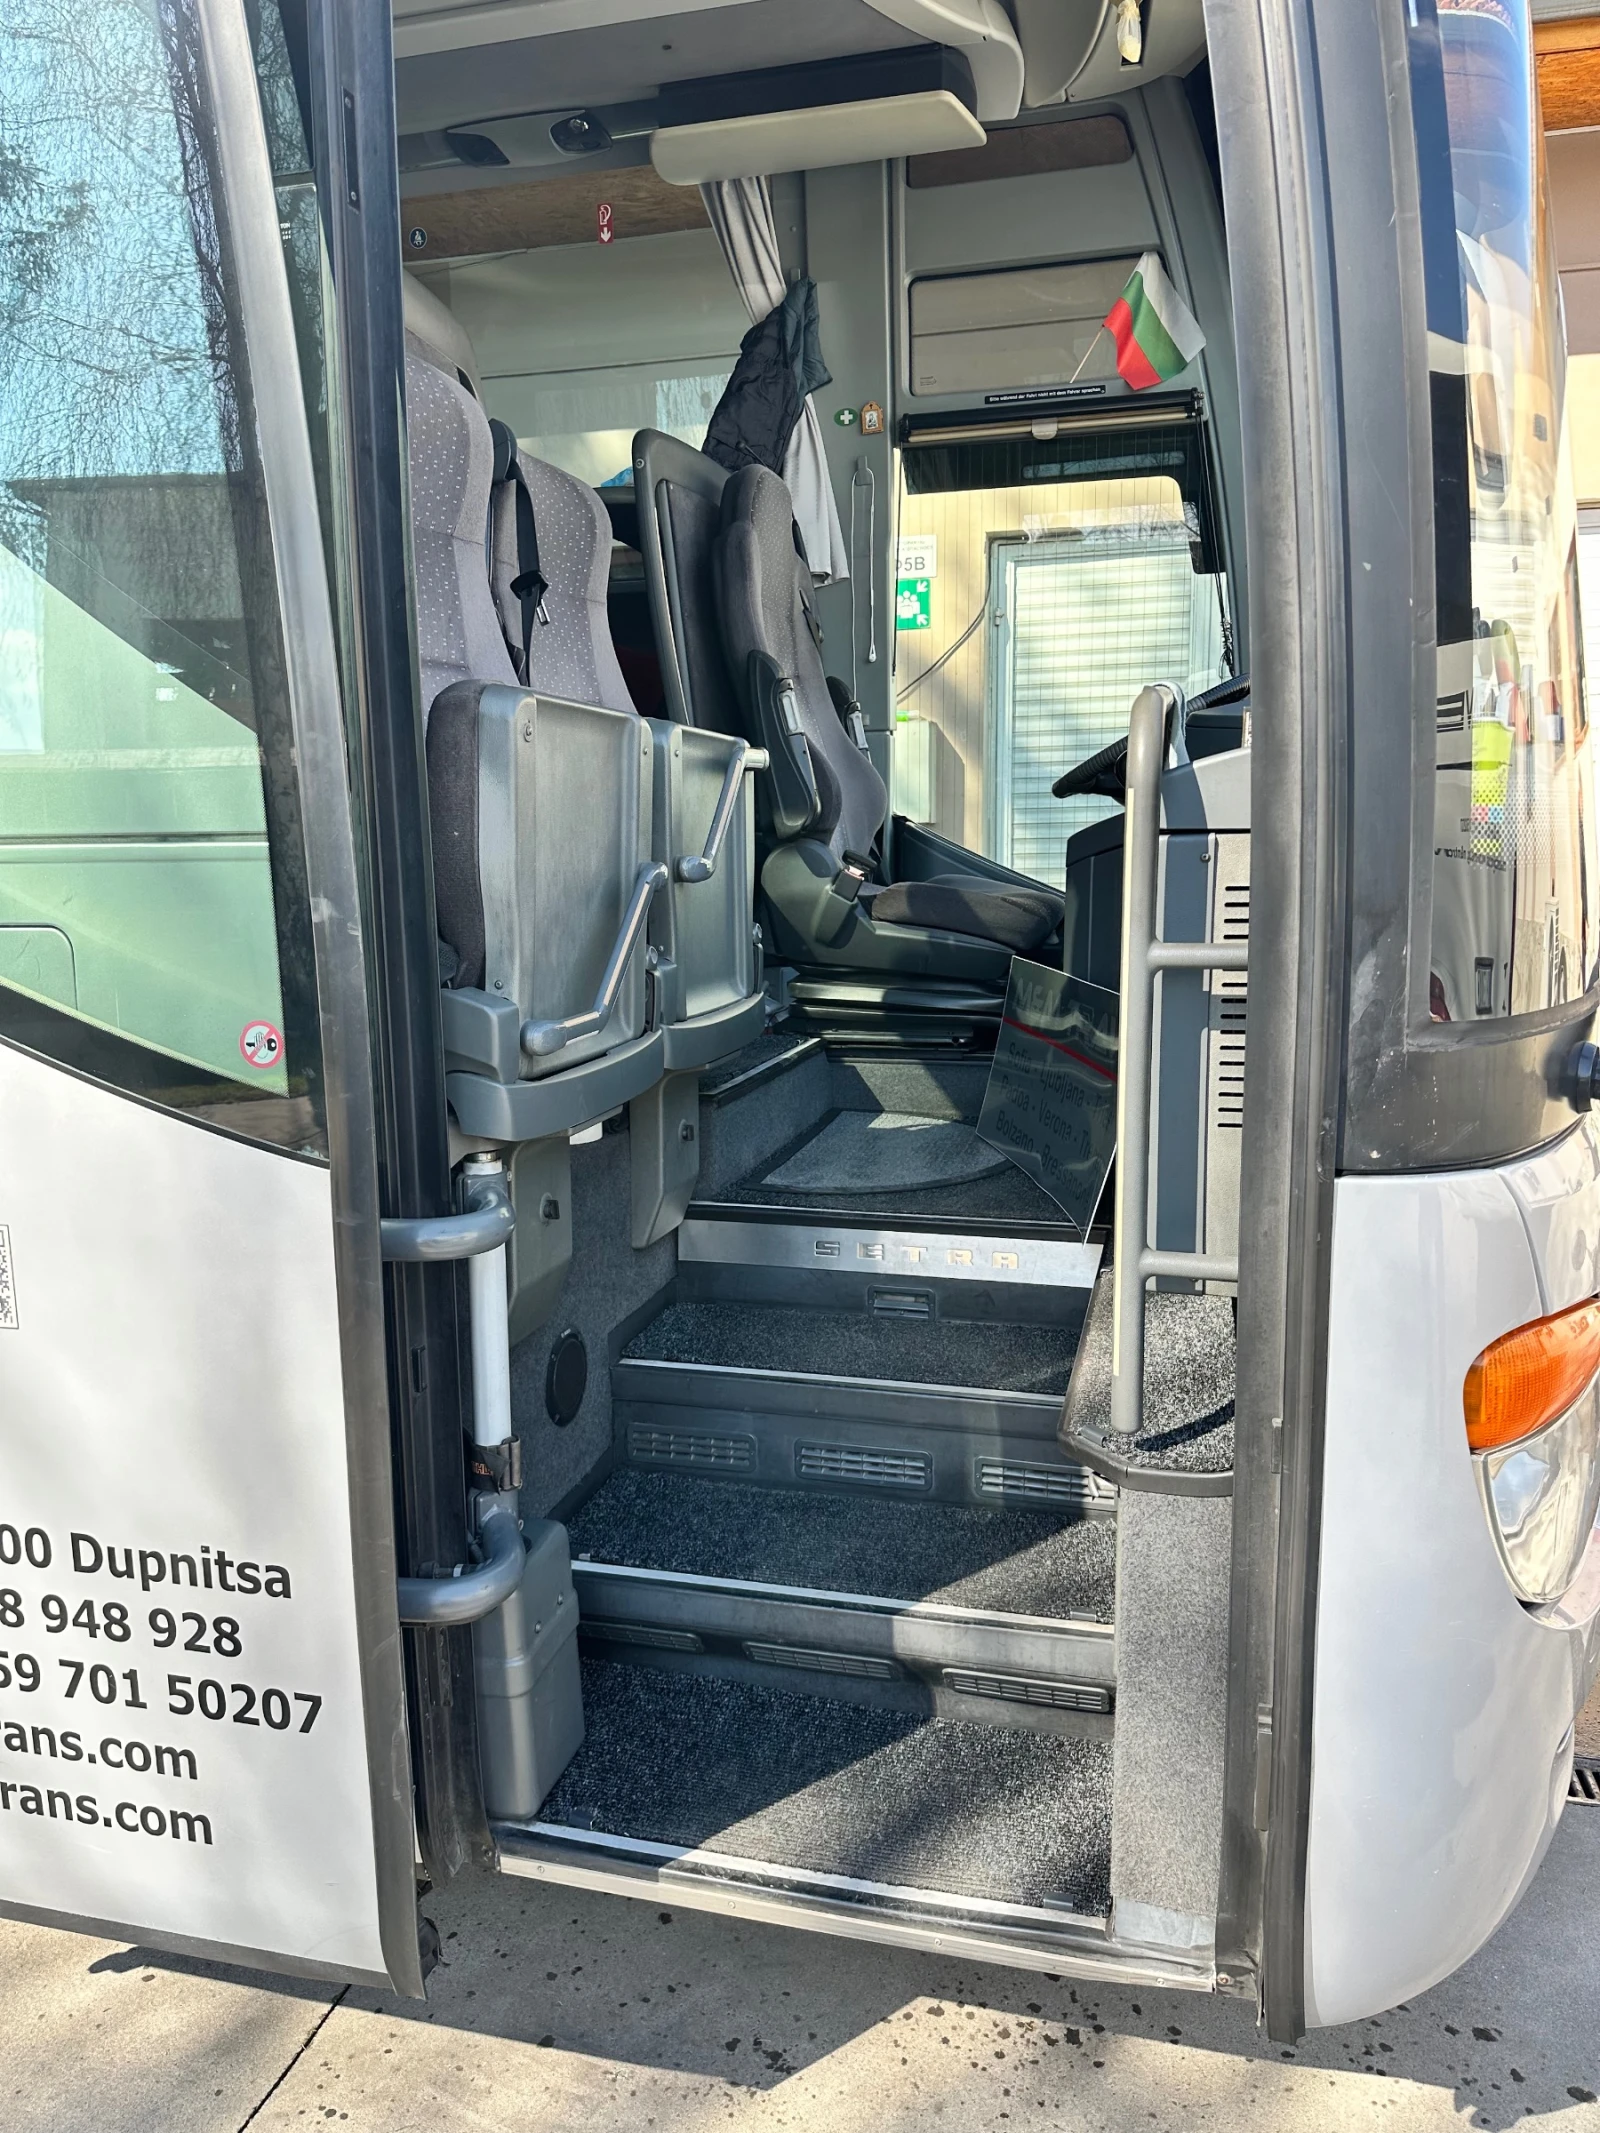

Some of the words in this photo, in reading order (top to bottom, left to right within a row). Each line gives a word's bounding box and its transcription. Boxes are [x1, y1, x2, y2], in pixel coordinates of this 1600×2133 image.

[1040, 1061, 1085, 1108] Ljubljana
[996, 1110, 1034, 1153] Bolzano
[1039, 1099, 1073, 1142] Verona
[814, 1240, 1019, 1269] SETRA
[70, 1532, 292, 1599] Dupnitsa
[41, 1594, 131, 1642] 948
[149, 1608, 243, 1657] 928
[58, 1659, 147, 1709] 701
[167, 1674, 322, 1733] 50207
[0, 1720, 198, 1780] ans.com
